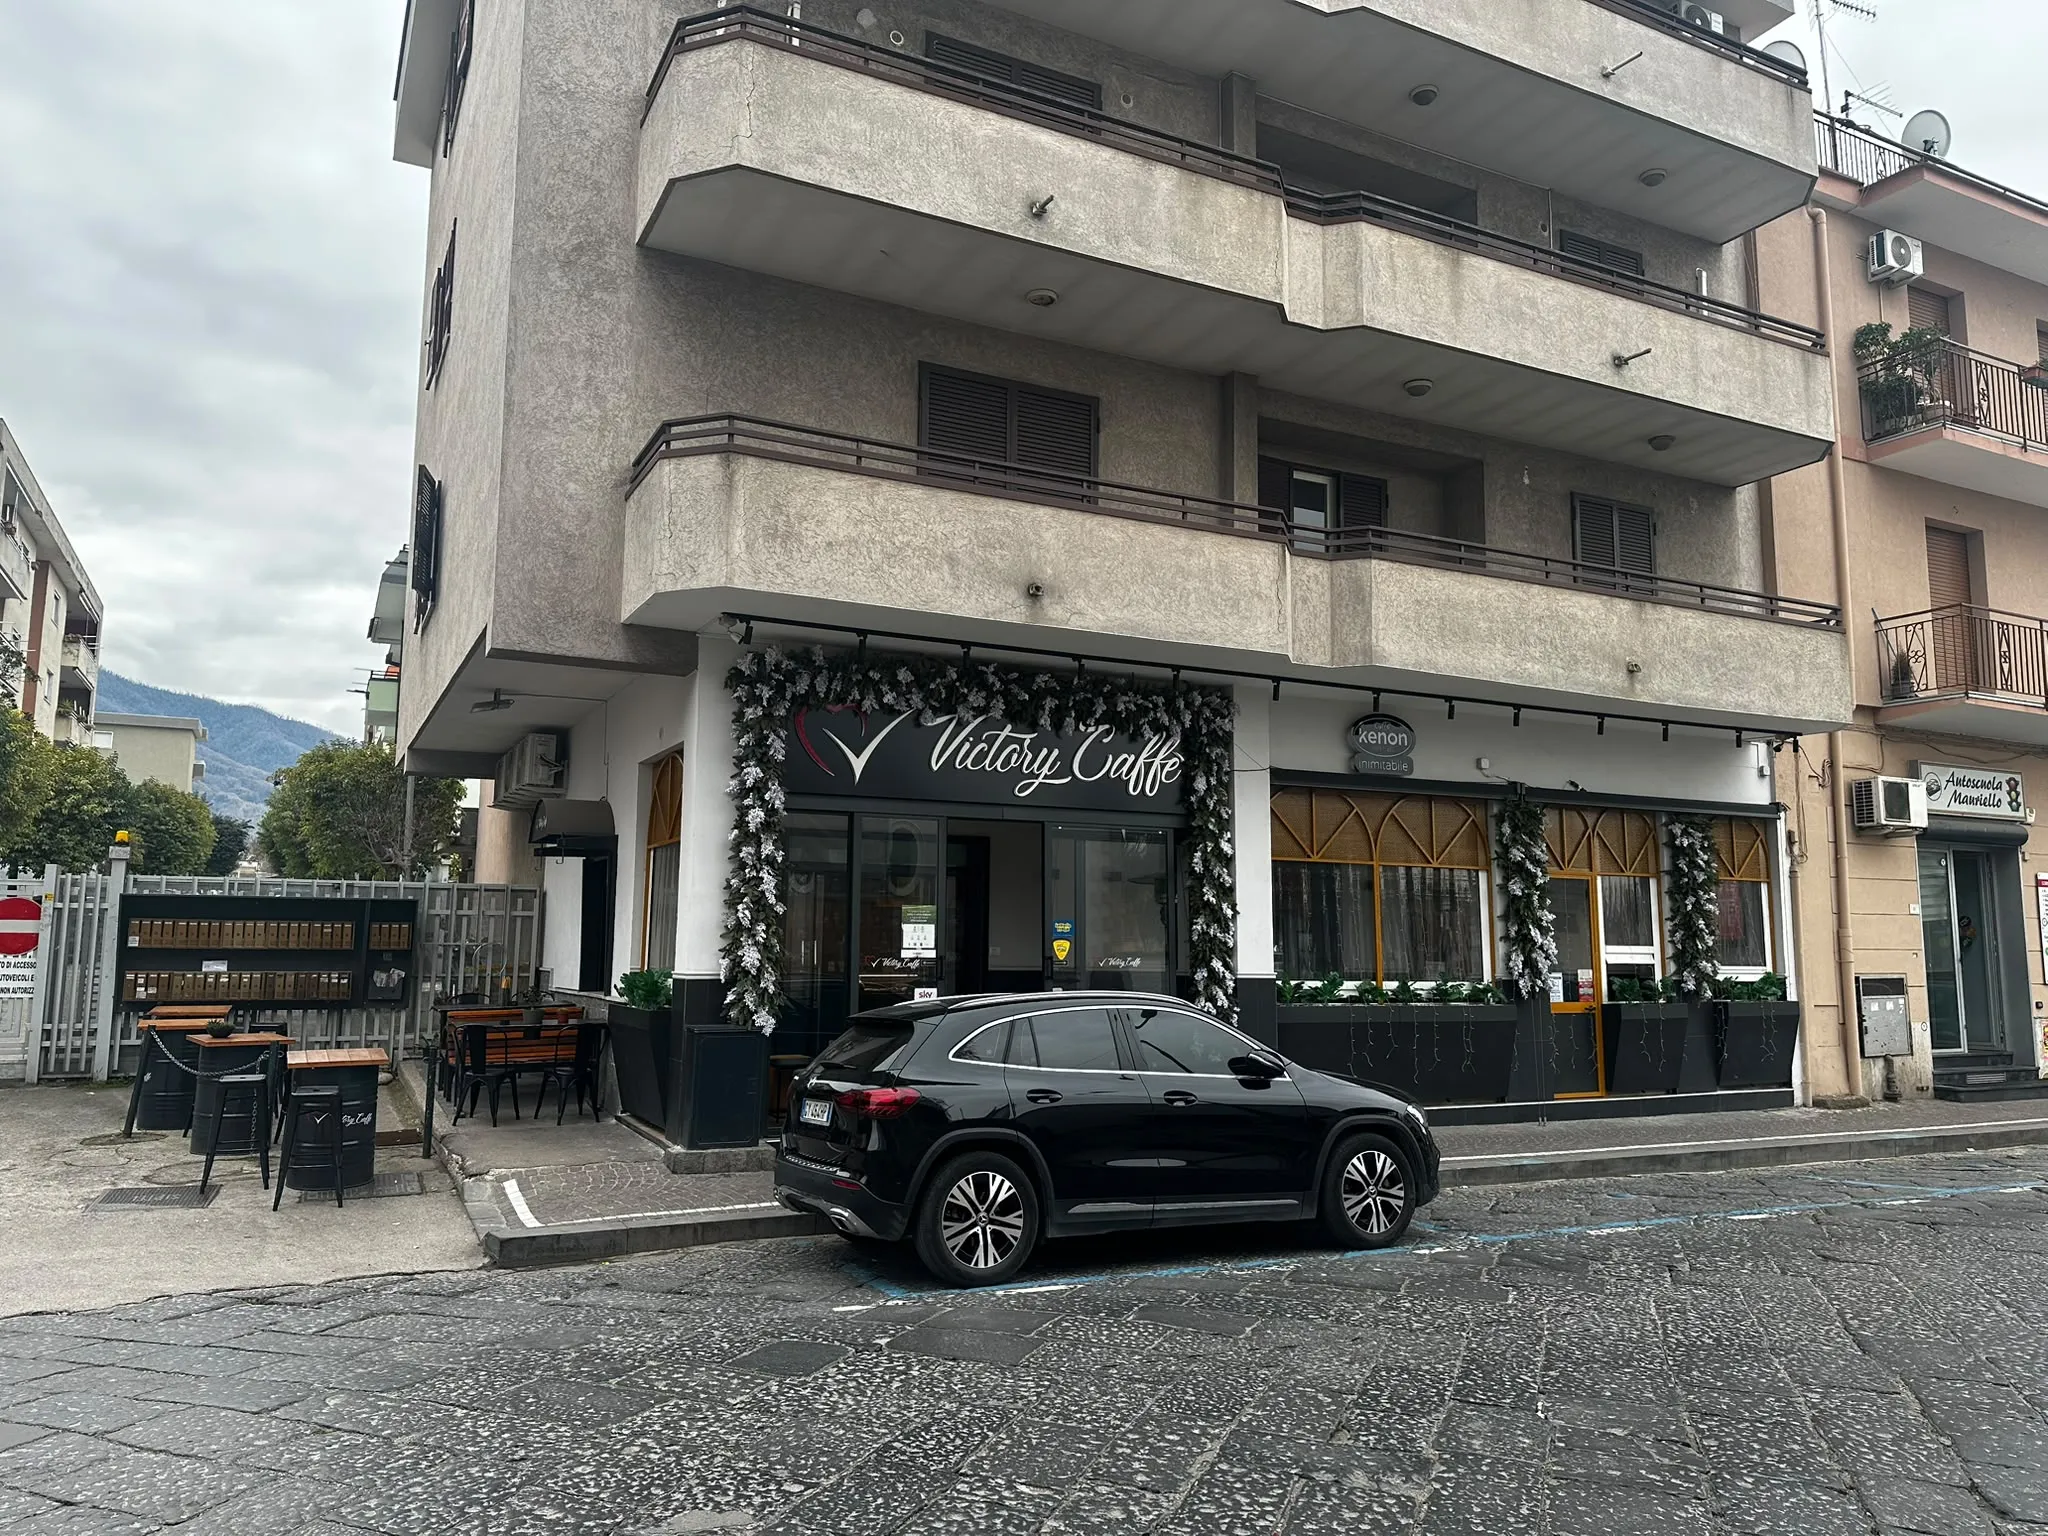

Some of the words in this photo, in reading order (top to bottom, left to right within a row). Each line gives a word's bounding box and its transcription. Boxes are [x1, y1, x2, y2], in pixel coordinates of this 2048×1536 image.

[1359, 727, 1408, 746] kenon
[920, 714, 1072, 797] Victory
[1072, 724, 1185, 797] Caffè
[1358, 760, 1409, 772] inimitabile
[1944, 770, 2003, 791] Autoscuola
[1947, 789, 2002, 808] Mauriello
[6, 961, 12, 969] DI
[13, 961, 37, 969] ACCESSO
[30, 974, 35, 982] E
[918, 989, 933, 999] sky
